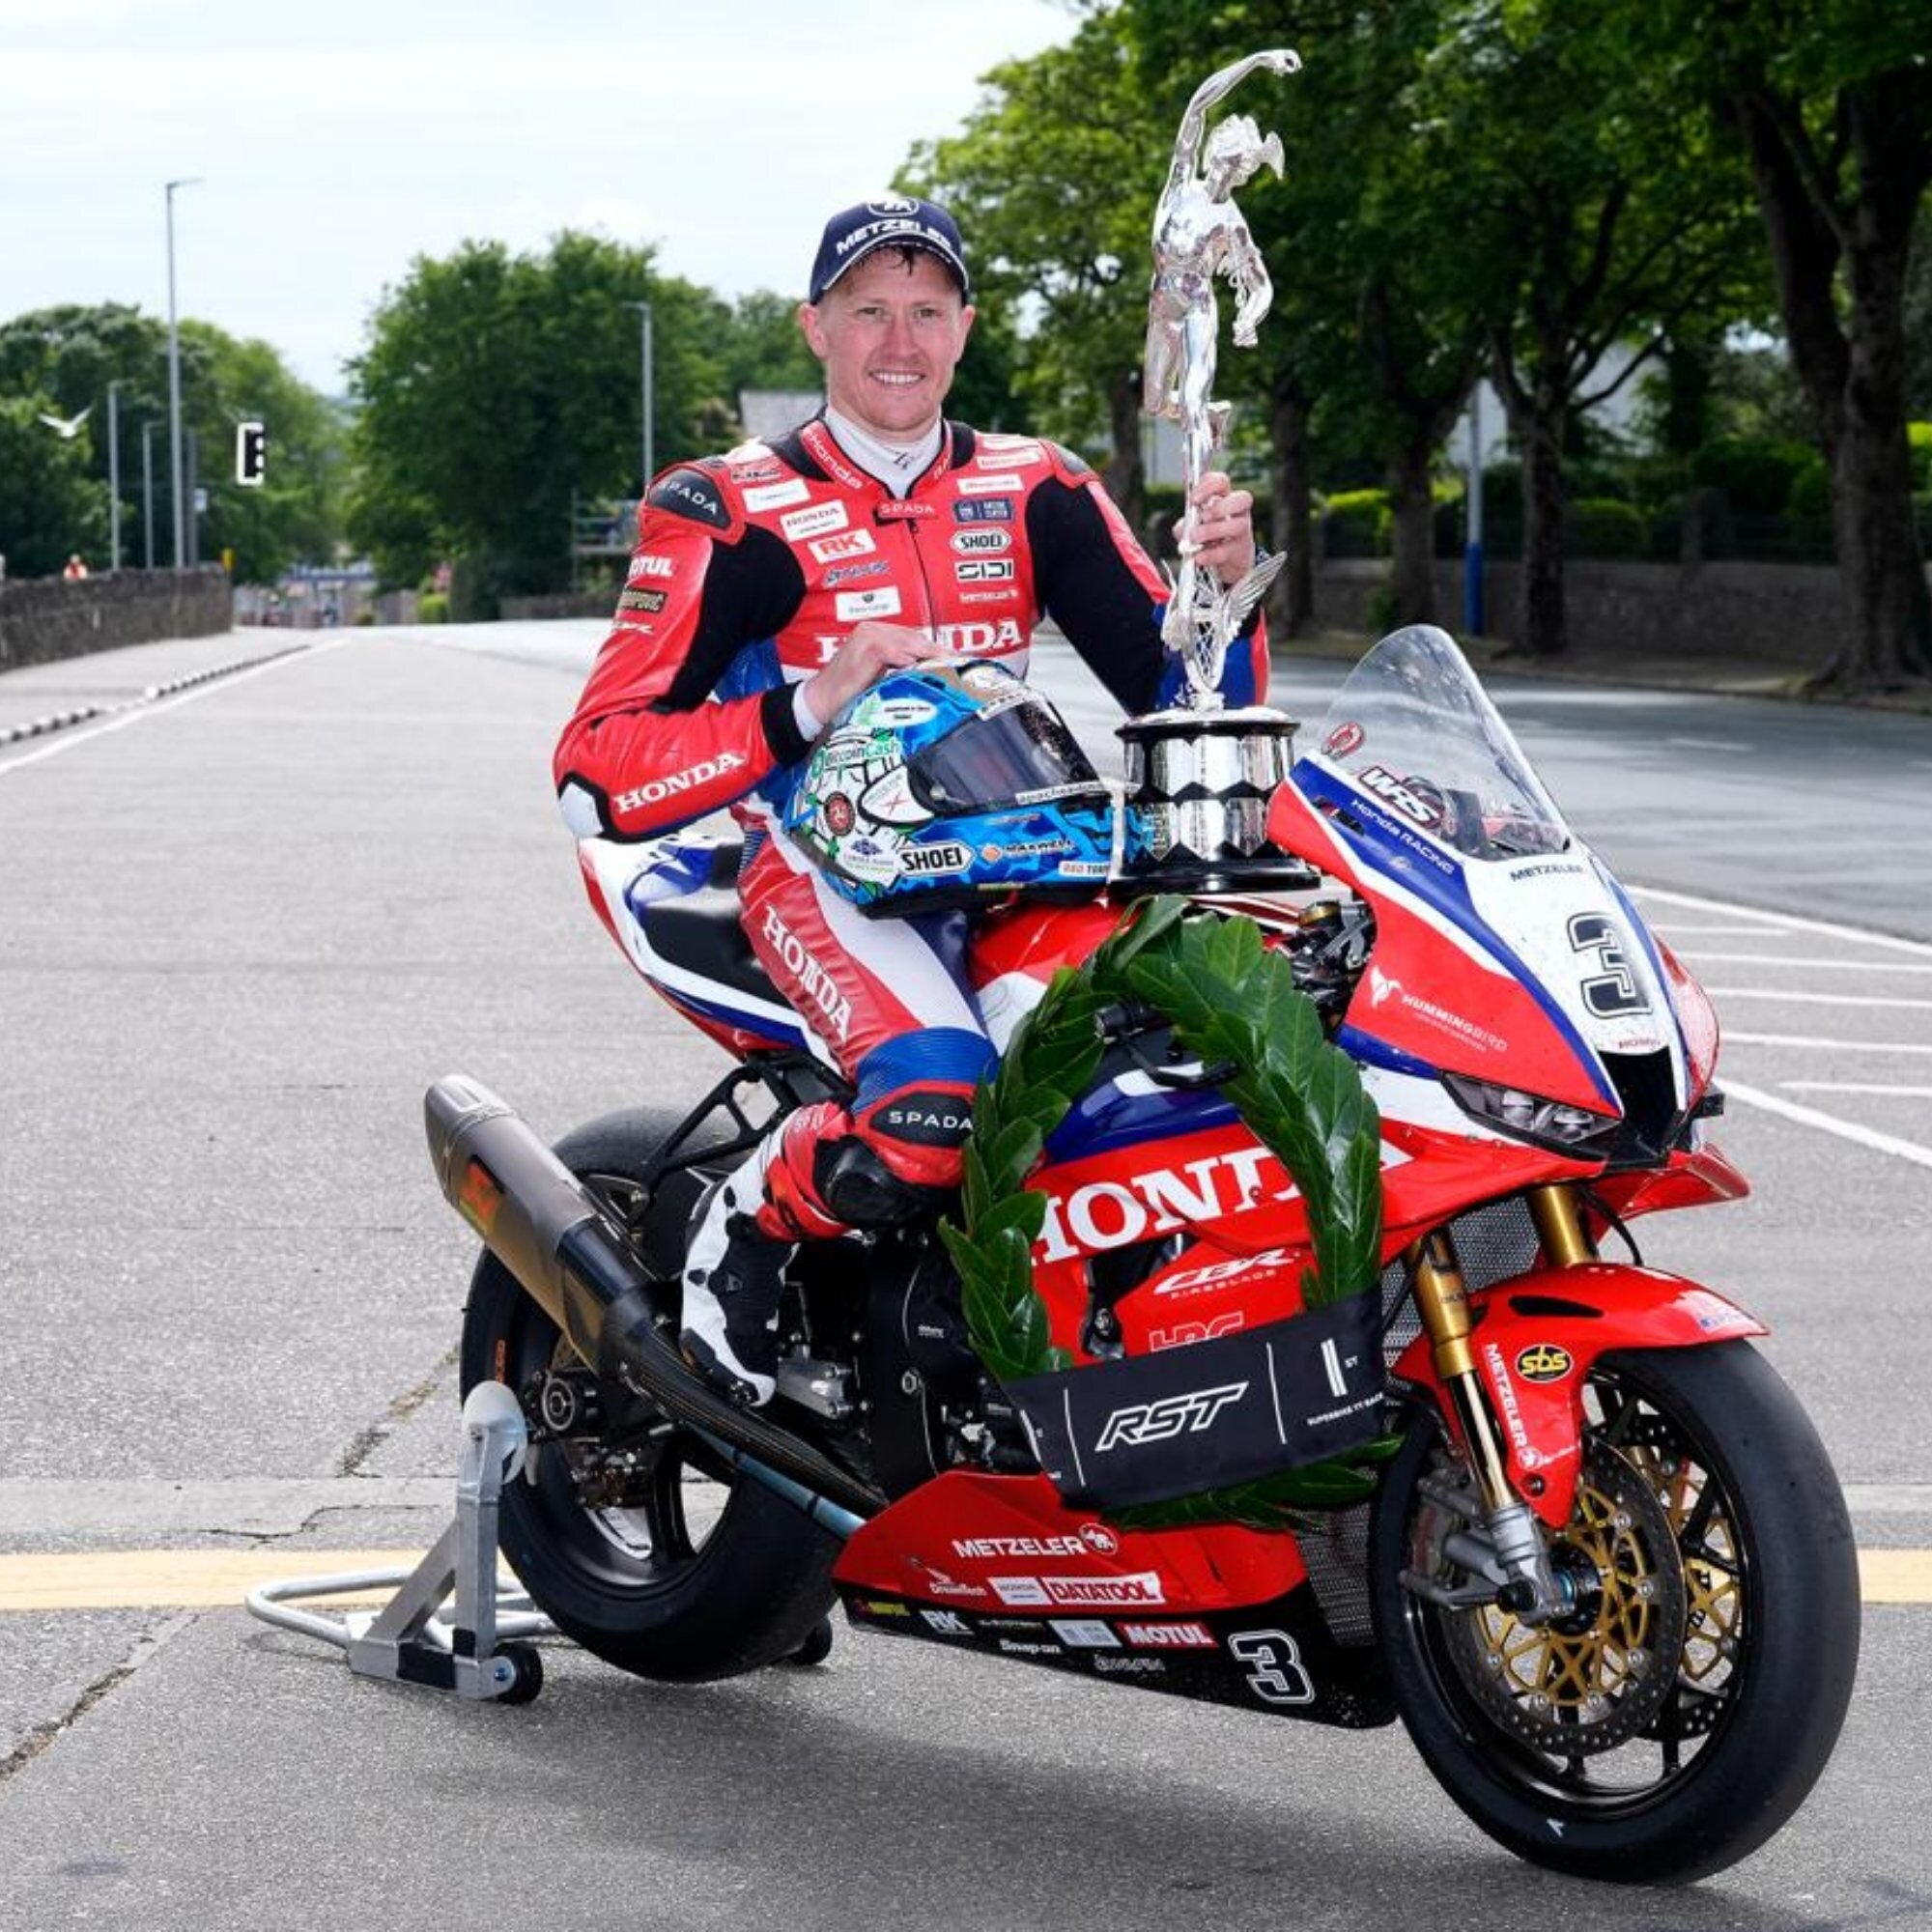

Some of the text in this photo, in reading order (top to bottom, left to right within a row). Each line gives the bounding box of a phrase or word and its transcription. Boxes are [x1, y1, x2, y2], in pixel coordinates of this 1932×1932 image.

[836, 219, 952, 255] METZELER
[881, 503, 935, 514] SPADA
[819, 533, 865, 554] RK
[960, 534, 1003, 549] SHOEI
[629, 554, 672, 578] OTUL
[958, 562, 1012, 579] SIDI
[613, 753, 747, 814] HONDA
[900, 847, 963, 871] SHOEI
[1400, 832, 1456, 875] RACING
[763, 904, 851, 1043] HONDA
[1567, 911, 1653, 1020] 3
[1402, 994, 1508, 1052] HUMMINGBIRD
[889, 1110, 974, 1130] SPADA
[1485, 1343, 1528, 1448] METZELER
[1094, 1380, 1249, 1451] RST
[952, 1536, 1087, 1558] METZELER
[1049, 1580, 1157, 1601] DATATOOL
[1123, 1625, 1216, 1643] MOTUL
[999, 1638, 1062, 1655] Snap-on
[1228, 1629, 1315, 1704] 3
